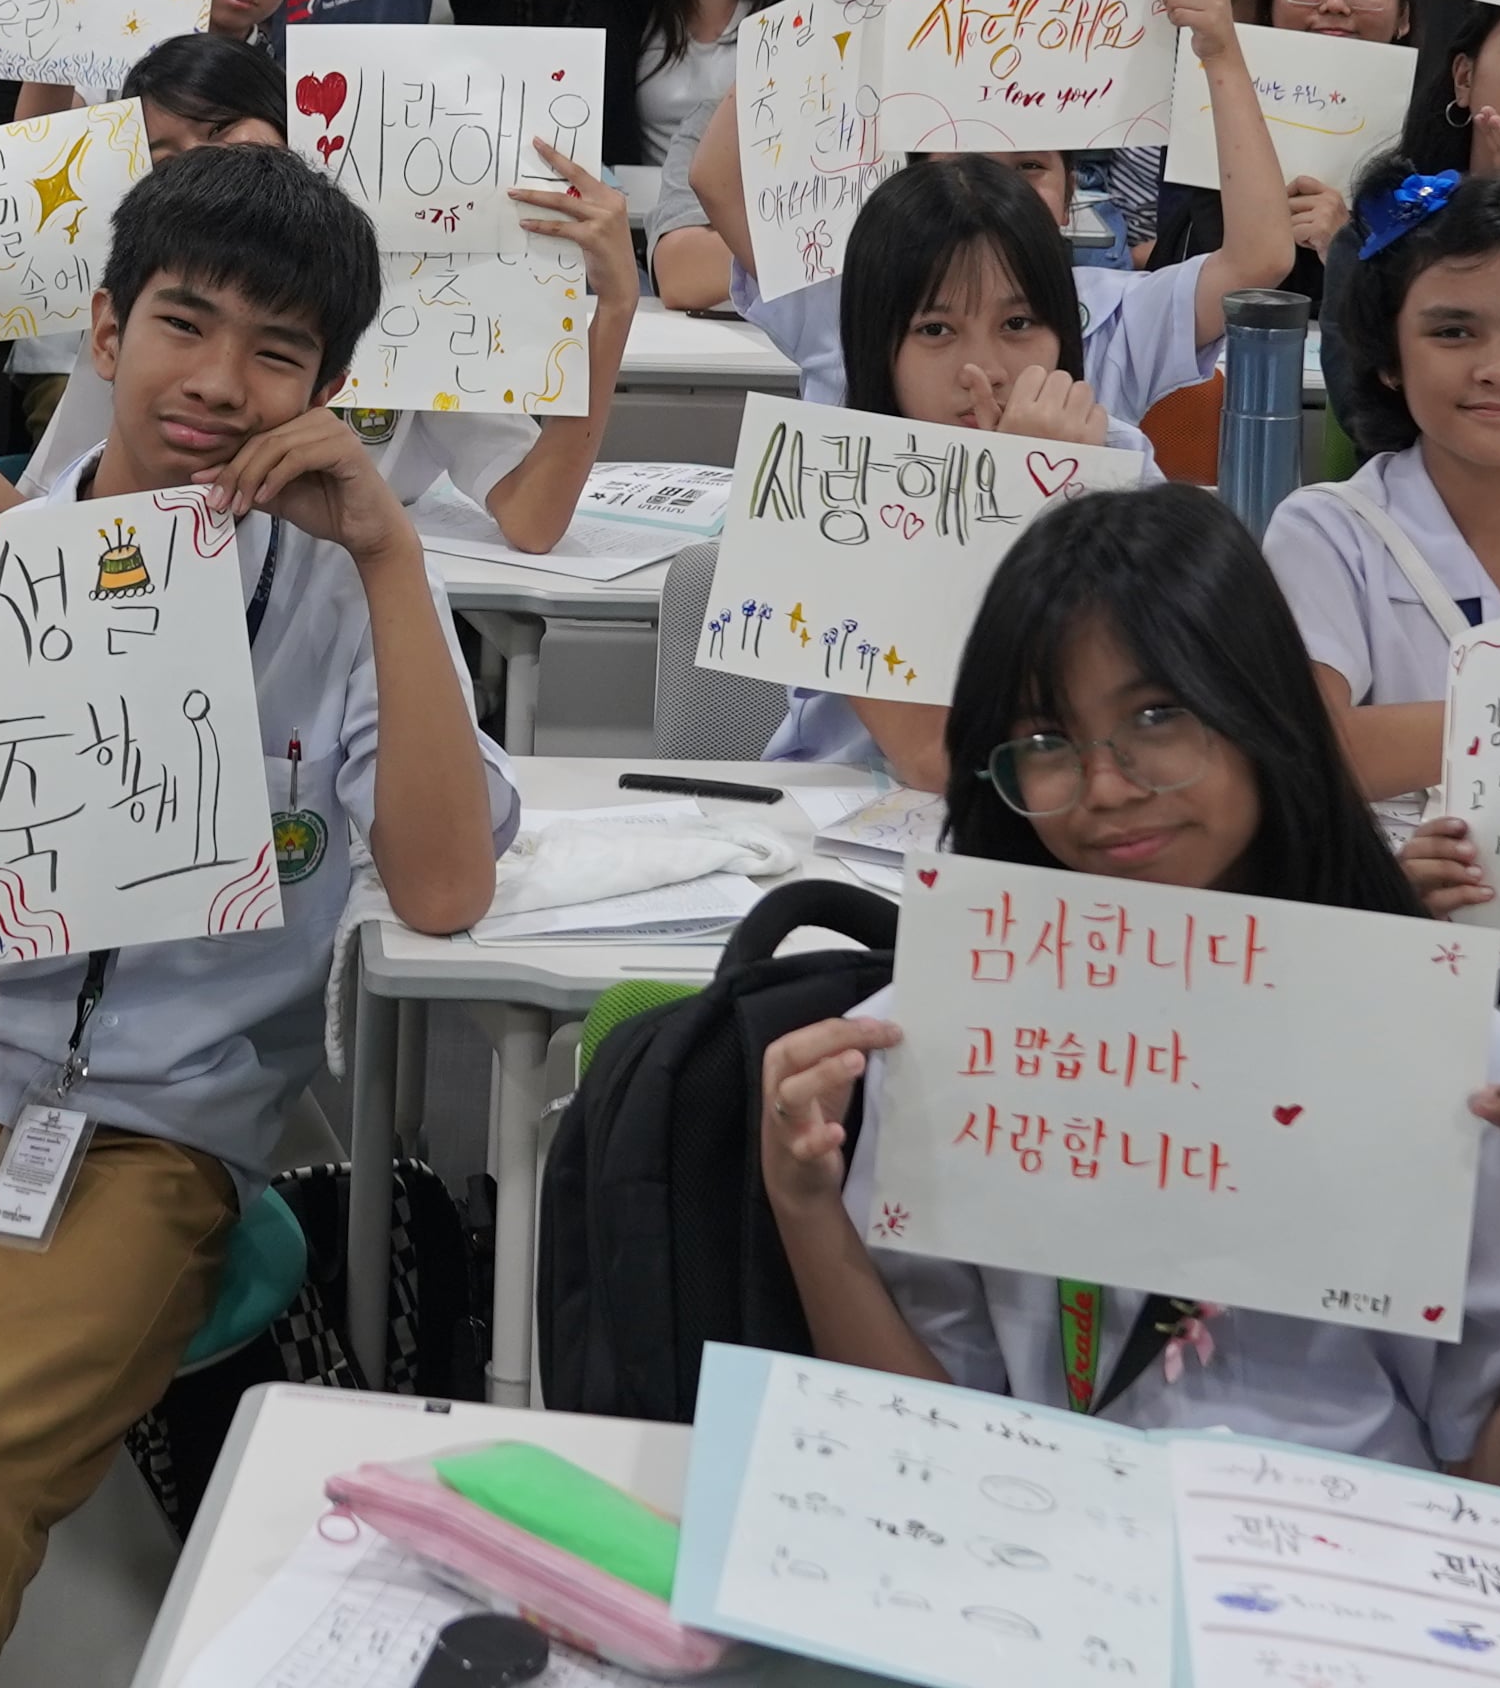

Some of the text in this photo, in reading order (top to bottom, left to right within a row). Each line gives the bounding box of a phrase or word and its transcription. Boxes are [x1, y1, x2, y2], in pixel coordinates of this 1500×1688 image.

[333, 67, 591, 203] 사랑해요
[978, 85, 992, 102] I
[1251, 75, 1287, 101] 나는
[19, 255, 91, 312] 속에
[749, 421, 1023, 547] 사랑해요
[966, 890, 1276, 991] 감사합니다.
[953, 1104, 1239, 1193] 사랑합니다.
[1059, 1290, 1094, 1402] Grade
